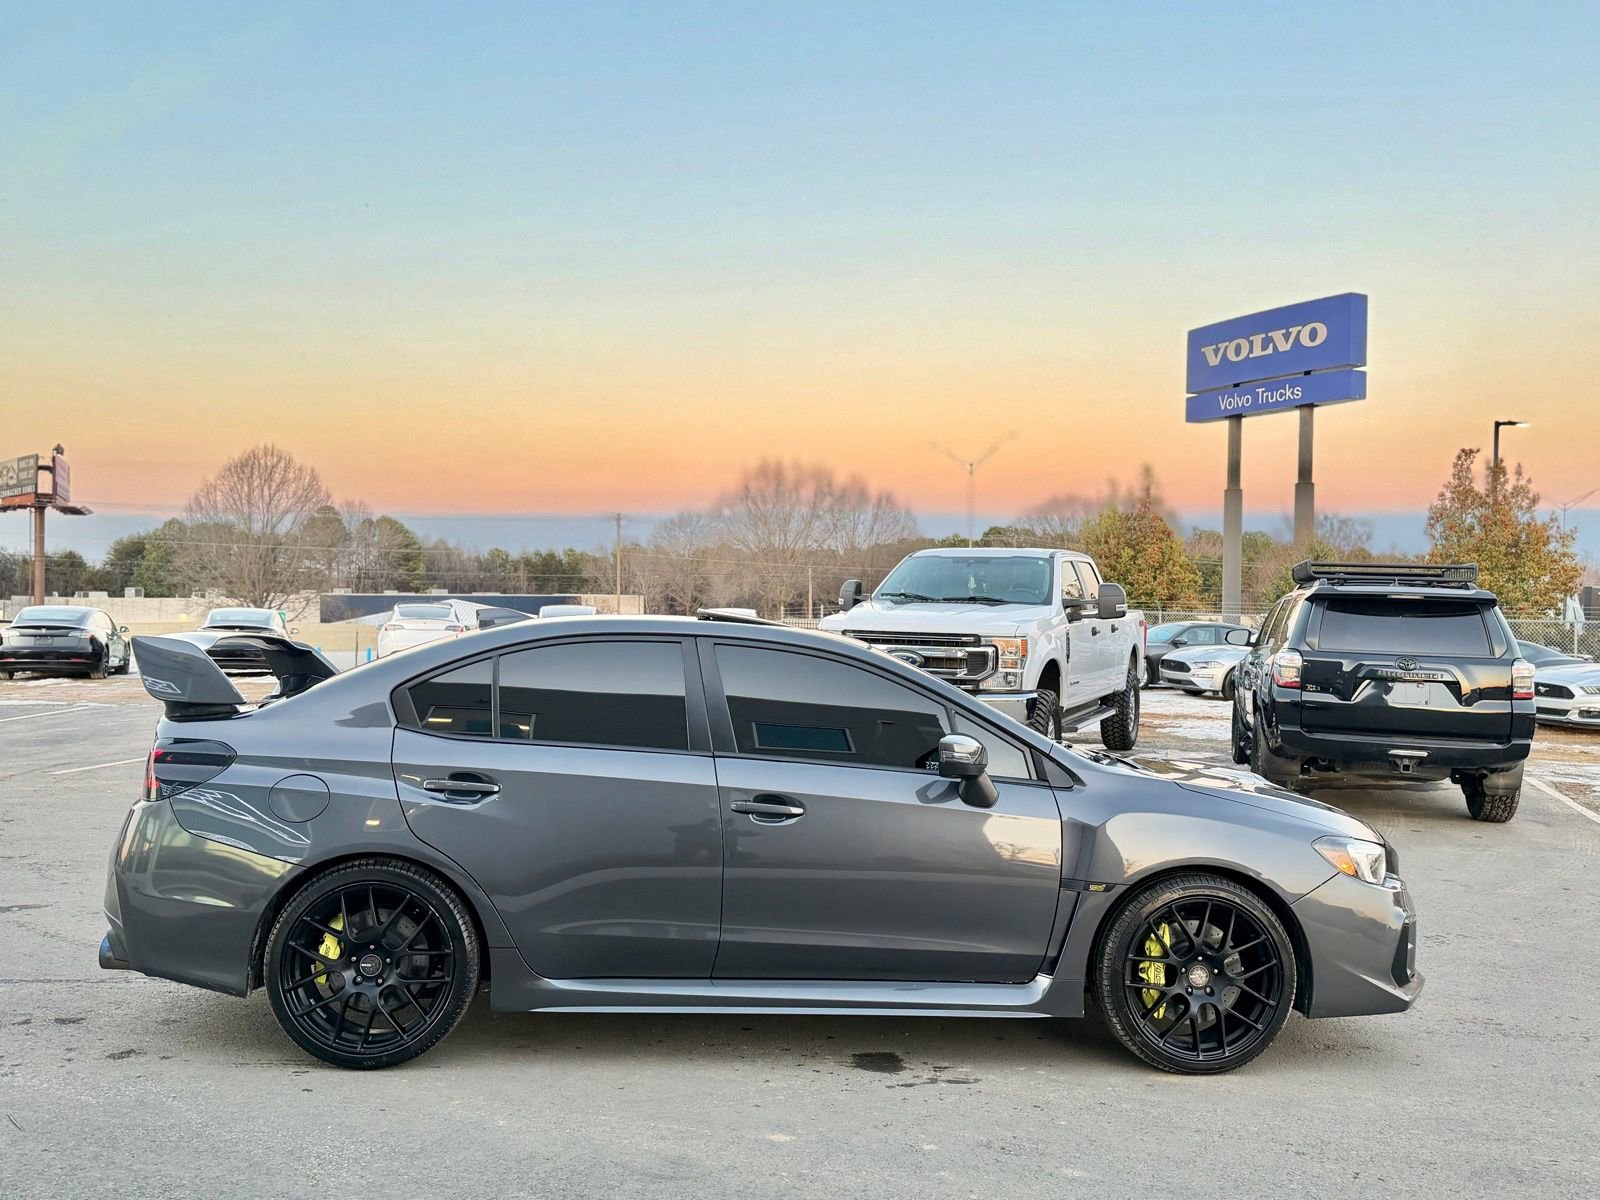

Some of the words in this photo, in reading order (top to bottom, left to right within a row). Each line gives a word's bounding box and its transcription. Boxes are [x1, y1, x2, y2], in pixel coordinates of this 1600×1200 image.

[1201, 322, 1328, 367] VOLVO
[1218, 392, 1252, 411] Volvo
[1256, 384, 1302, 404] Trucks
